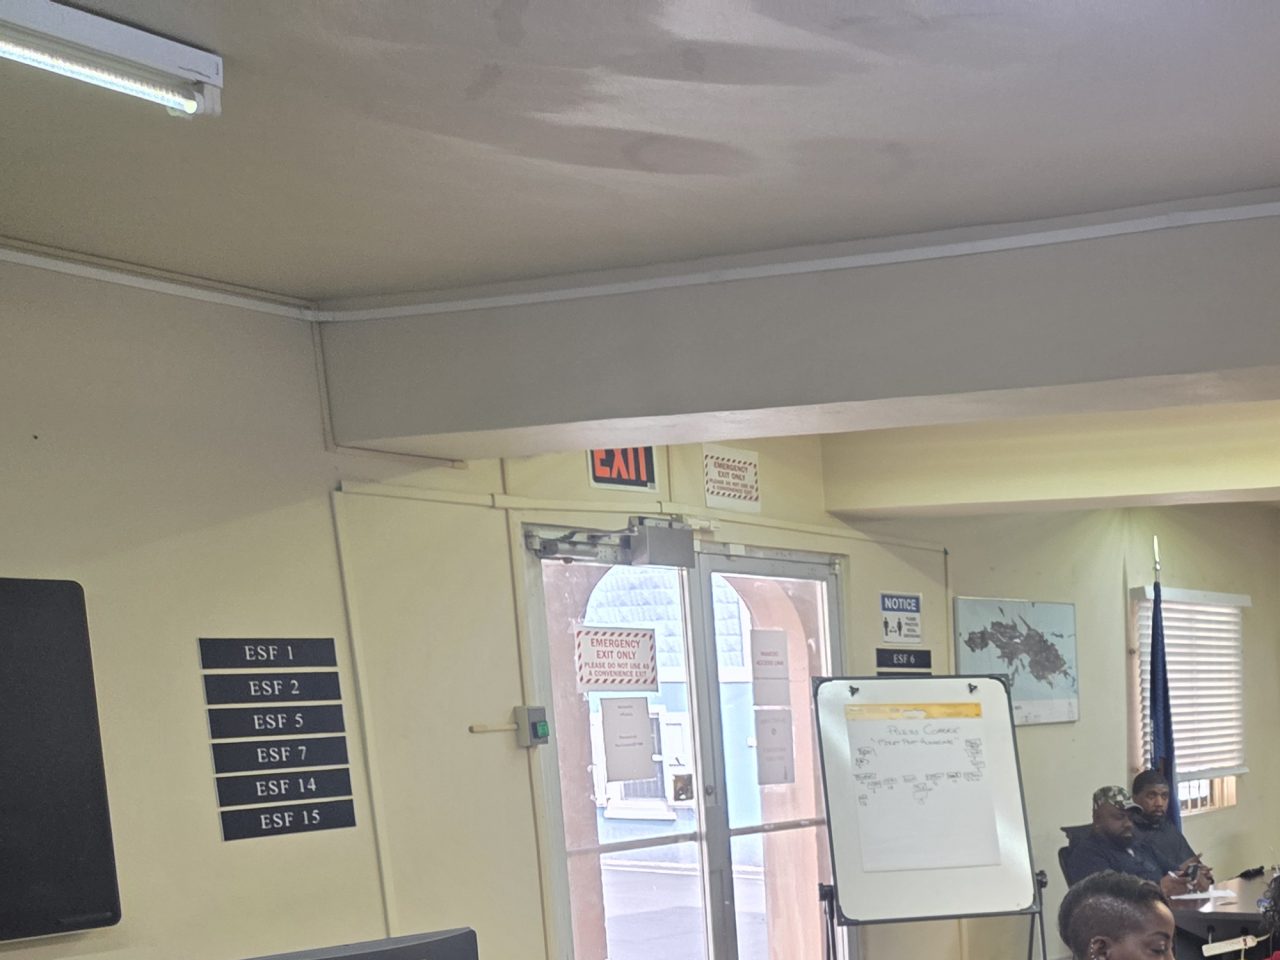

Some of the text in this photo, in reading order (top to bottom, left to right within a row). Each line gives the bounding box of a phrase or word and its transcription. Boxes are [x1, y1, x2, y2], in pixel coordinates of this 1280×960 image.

[594, 446, 647, 481] EXIT
[884, 597, 917, 610] NOTICE
[591, 638, 641, 648] EMERGENCY
[245, 646, 293, 660] ESF 1
[596, 650, 636, 660] EXIT ONLY
[893, 654, 915, 664] ESF 6
[249, 680, 300, 695] ESF 2
[253, 713, 304, 729] ESF 5
[257, 746, 307, 763] ESF 7
[256, 777, 316, 796] ESF 14
[260, 810, 320, 829] ESF 15
